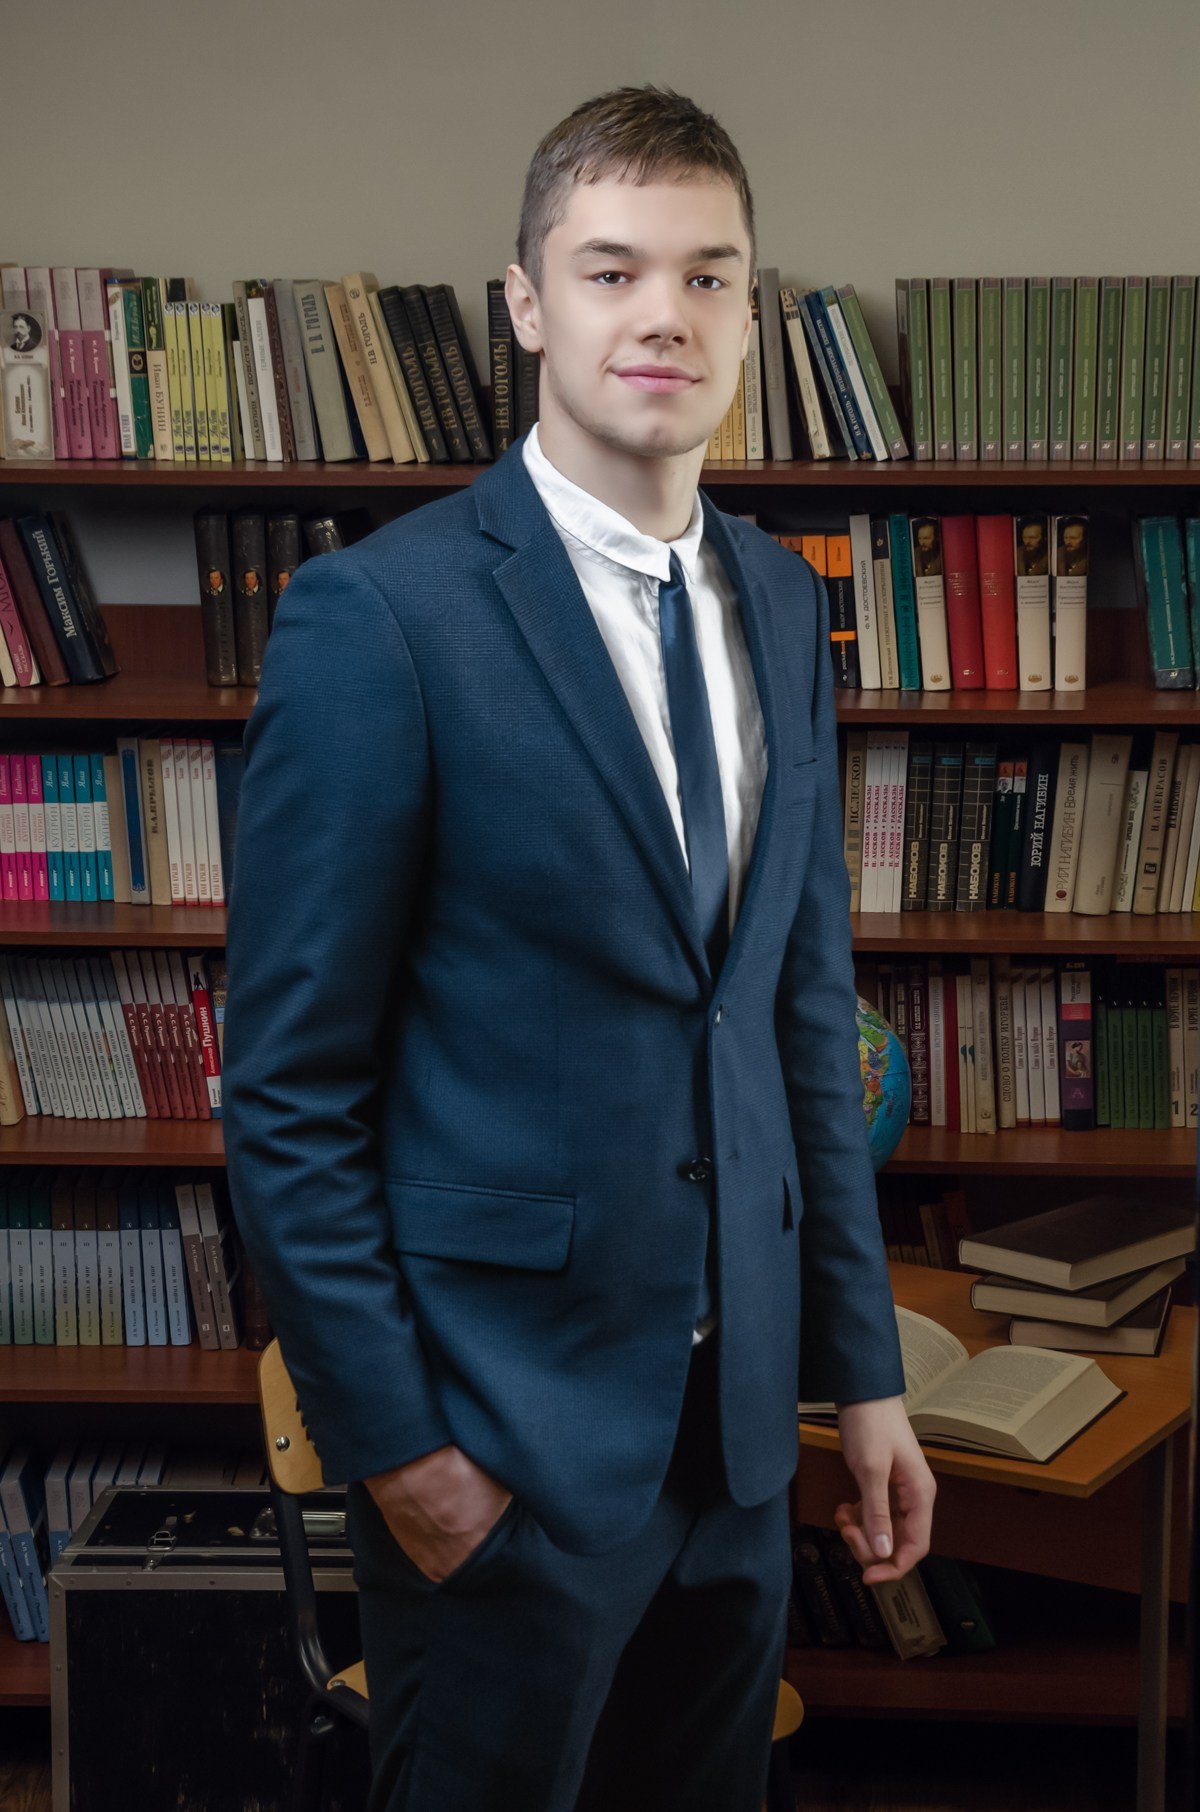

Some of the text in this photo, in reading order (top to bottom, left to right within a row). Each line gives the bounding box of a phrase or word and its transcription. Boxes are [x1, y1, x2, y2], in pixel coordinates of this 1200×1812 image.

[301, 294, 321, 330] ГОГОЛЬ
[357, 312, 373, 347] ГОГОЛЬ
[153, 363, 166, 432] Иван БУНИН
[453, 437, 462, 450] 2
[473, 437, 483, 450] 3
[31, 529, 78, 640] Максим Горький
[860, 560, 870, 612] ДОСТОЕВСКИЙ
[61, 770, 70, 788] Яма
[78, 770, 86, 788] Яма
[5, 813, 13, 844] КУПРИН
[20, 811, 30, 843] КУПРИН
[37, 812, 46, 844] КУПРИН
[49, 806, 61, 849] КУПРИН
[65, 806, 77, 849] КУПРИН
[81, 806, 93, 849] КУПРИН
[98, 805, 111, 848] КУПРИН
[1030, 773, 1049, 867] ЮРИЙ НАГИБИН
[1055, 754, 1079, 901] ЮРИЙ НАГИБИН Время жить
[909, 841, 919, 898] НАБОКОВ
[937, 843, 948, 900] НАБОКОВ
[969, 842, 982, 900] НАБОКОВ
[1007, 871, 1016, 903] НАБОКОВ
[992, 872, 1000, 904] НАБОКОВ
[199, 1006, 214, 1047] Пушкин
[999, 995, 1009, 1033] ИГОРЕВЕ
[1169, 1004, 1179, 1023] КРУГЕ
[1188, 1006, 1198, 1026] КРУГЕ
[1000, 1036, 1010, 1064] ПОЛКУ
[1003, 1074, 1012, 1102] СЛОВО
[1172, 1101, 1179, 1115] 1
[1190, 1103, 1198, 1116] 2
